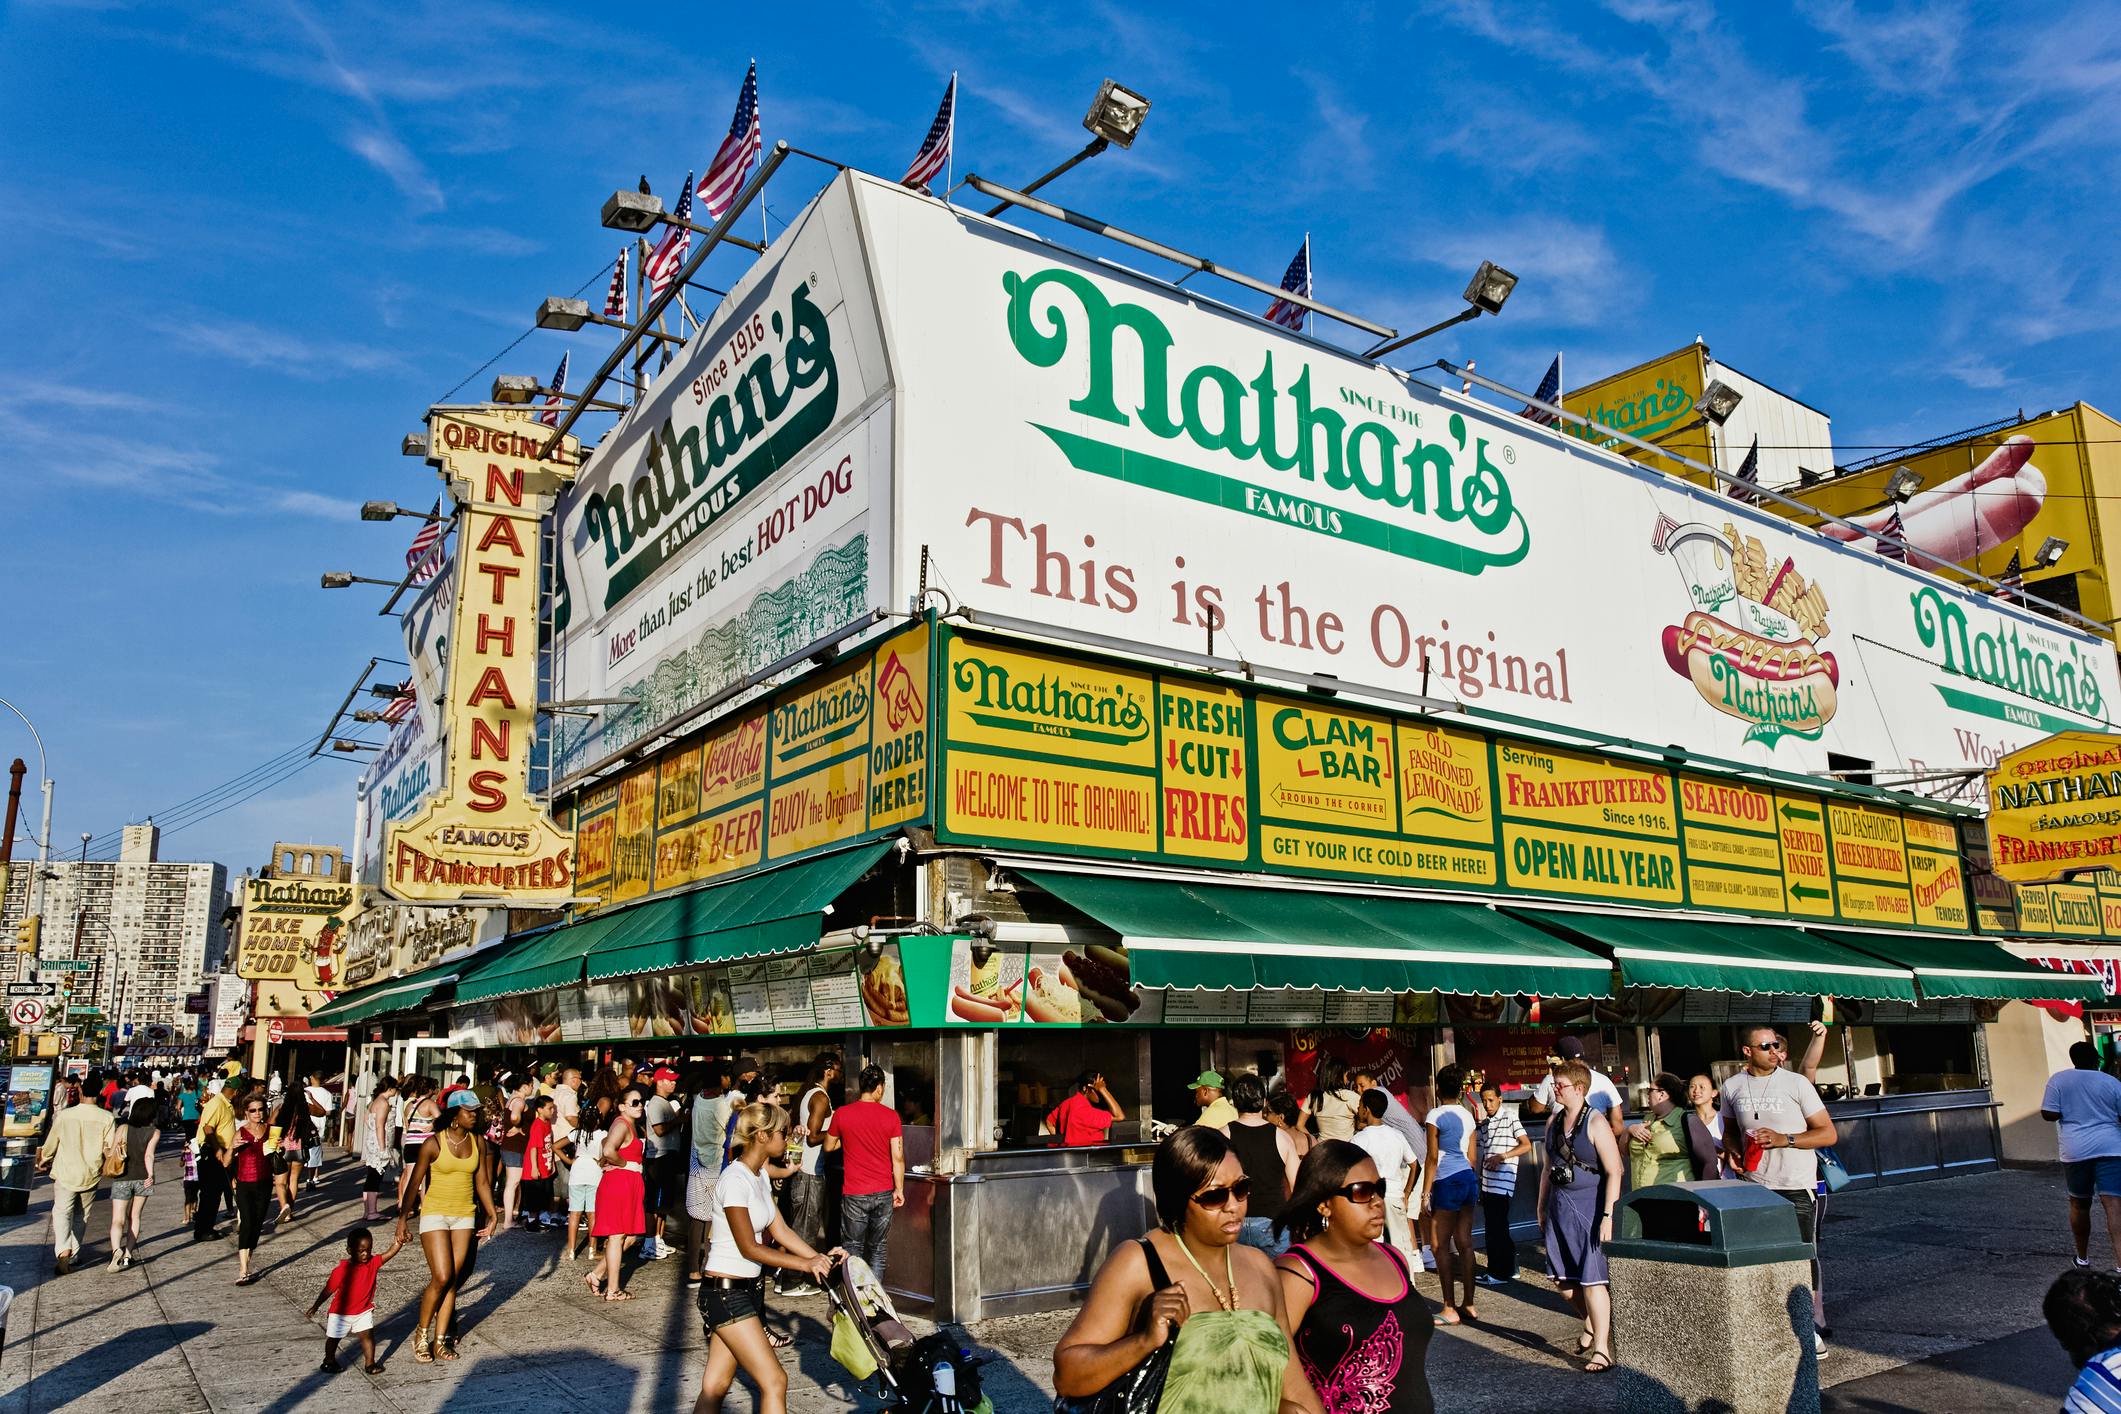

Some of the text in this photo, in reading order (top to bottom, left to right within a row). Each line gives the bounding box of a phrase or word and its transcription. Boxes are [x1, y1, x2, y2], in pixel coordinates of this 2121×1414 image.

[692, 313, 765, 406] Since 1916
[1002, 268, 1516, 535] Nathan's
[1339, 386, 1424, 429] SINCE 1916
[443, 423, 565, 464] ORIGINL
[586, 281, 832, 570] Nathan's
[660, 475, 741, 558] FAMOUS
[1245, 486, 1343, 534] FAMOUS
[608, 454, 853, 665] More than just the best HOT DOG
[965, 506, 1573, 705] This is the Original
[1692, 579, 1733, 604] Nathan's
[1750, 605, 1788, 632] Nathan's
[467, 463, 524, 814] NATHANS
[1910, 586, 2102, 717] Nathan's
[953, 657, 1144, 730] Nathan's
[1070, 681, 1091, 692] SINCE
[1709, 653, 1818, 723] Nathan's
[774, 672, 868, 747] Nathan's
[1162, 693, 1243, 738] FRESH
[2004, 705, 2042, 728] FAMOUS
[1032, 723, 1072, 738] FAMOUS
[1272, 708, 1373, 752] CLAM
[1426, 731, 1453, 758] OLD
[1753, 724, 1781, 735] FAMOUS
[873, 729, 925, 776] ORDER
[1180, 741, 1230, 779] CUT
[1319, 750, 1381, 788] BAR
[1408, 749, 1473, 787] FASHIONED
[1502, 746, 1554, 774] Serving
[594, 783, 618, 804] COLD
[770, 778, 864, 838] ENJOY the Original!
[871, 768, 925, 817] HERE!
[955, 768, 1150, 835] WELCOME TO THE ORIGINAL!
[1280, 791, 1384, 814] AROUND THE CORNER
[1404, 767, 1484, 814] LEMONADE
[1506, 772, 1667, 808] FRANKFURTERS
[1683, 781, 1768, 822] SEAFOOD
[627, 805, 644, 831] THE
[1164, 786, 1246, 846] FRIES
[1603, 808, 1670, 831] Since 1916.
[1832, 809, 1900, 844] OLD FASHIONED
[2037, 808, 2121, 831] FAMOUS
[441, 827, 530, 849] FAMOUS
[655, 808, 762, 881] ROOT BEER
[1273, 837, 1487, 876] GET YOUR ICE COLD BEER HERE!
[1783, 828, 1823, 854] SERVED
[395, 839, 572, 890] FRANKFURTERS
[1514, 836, 1676, 891] OPEN ALL YEAR
[1787, 853, 1825, 877] INSIDE
[1835, 841, 1903, 873] CHEESEBURGERS
[1911, 855, 1937, 873] KRISPY
[248, 879, 353, 906] Nathan's
[1842, 890, 1850, 909] All
[1875, 895, 1894, 913] 100%
[1894, 897, 1909, 915] BEEF
[1915, 865, 1960, 908] CHICKEN
[2021, 889, 2046, 905] SERVED
[249, 917, 304, 934] TAKE
[1934, 906, 1965, 923] TENDERS
[2023, 908, 2049, 924] INSIDE
[2052, 890, 2099, 927] CHICKEN
[243, 935, 302, 951] HOME
[42, 961, 79, 970] Stillwell
[240, 953, 298, 973] FOOD
[123, 1046, 204, 1056] ELDORAD
[1368, 1049, 1394, 1071] ISLAND
